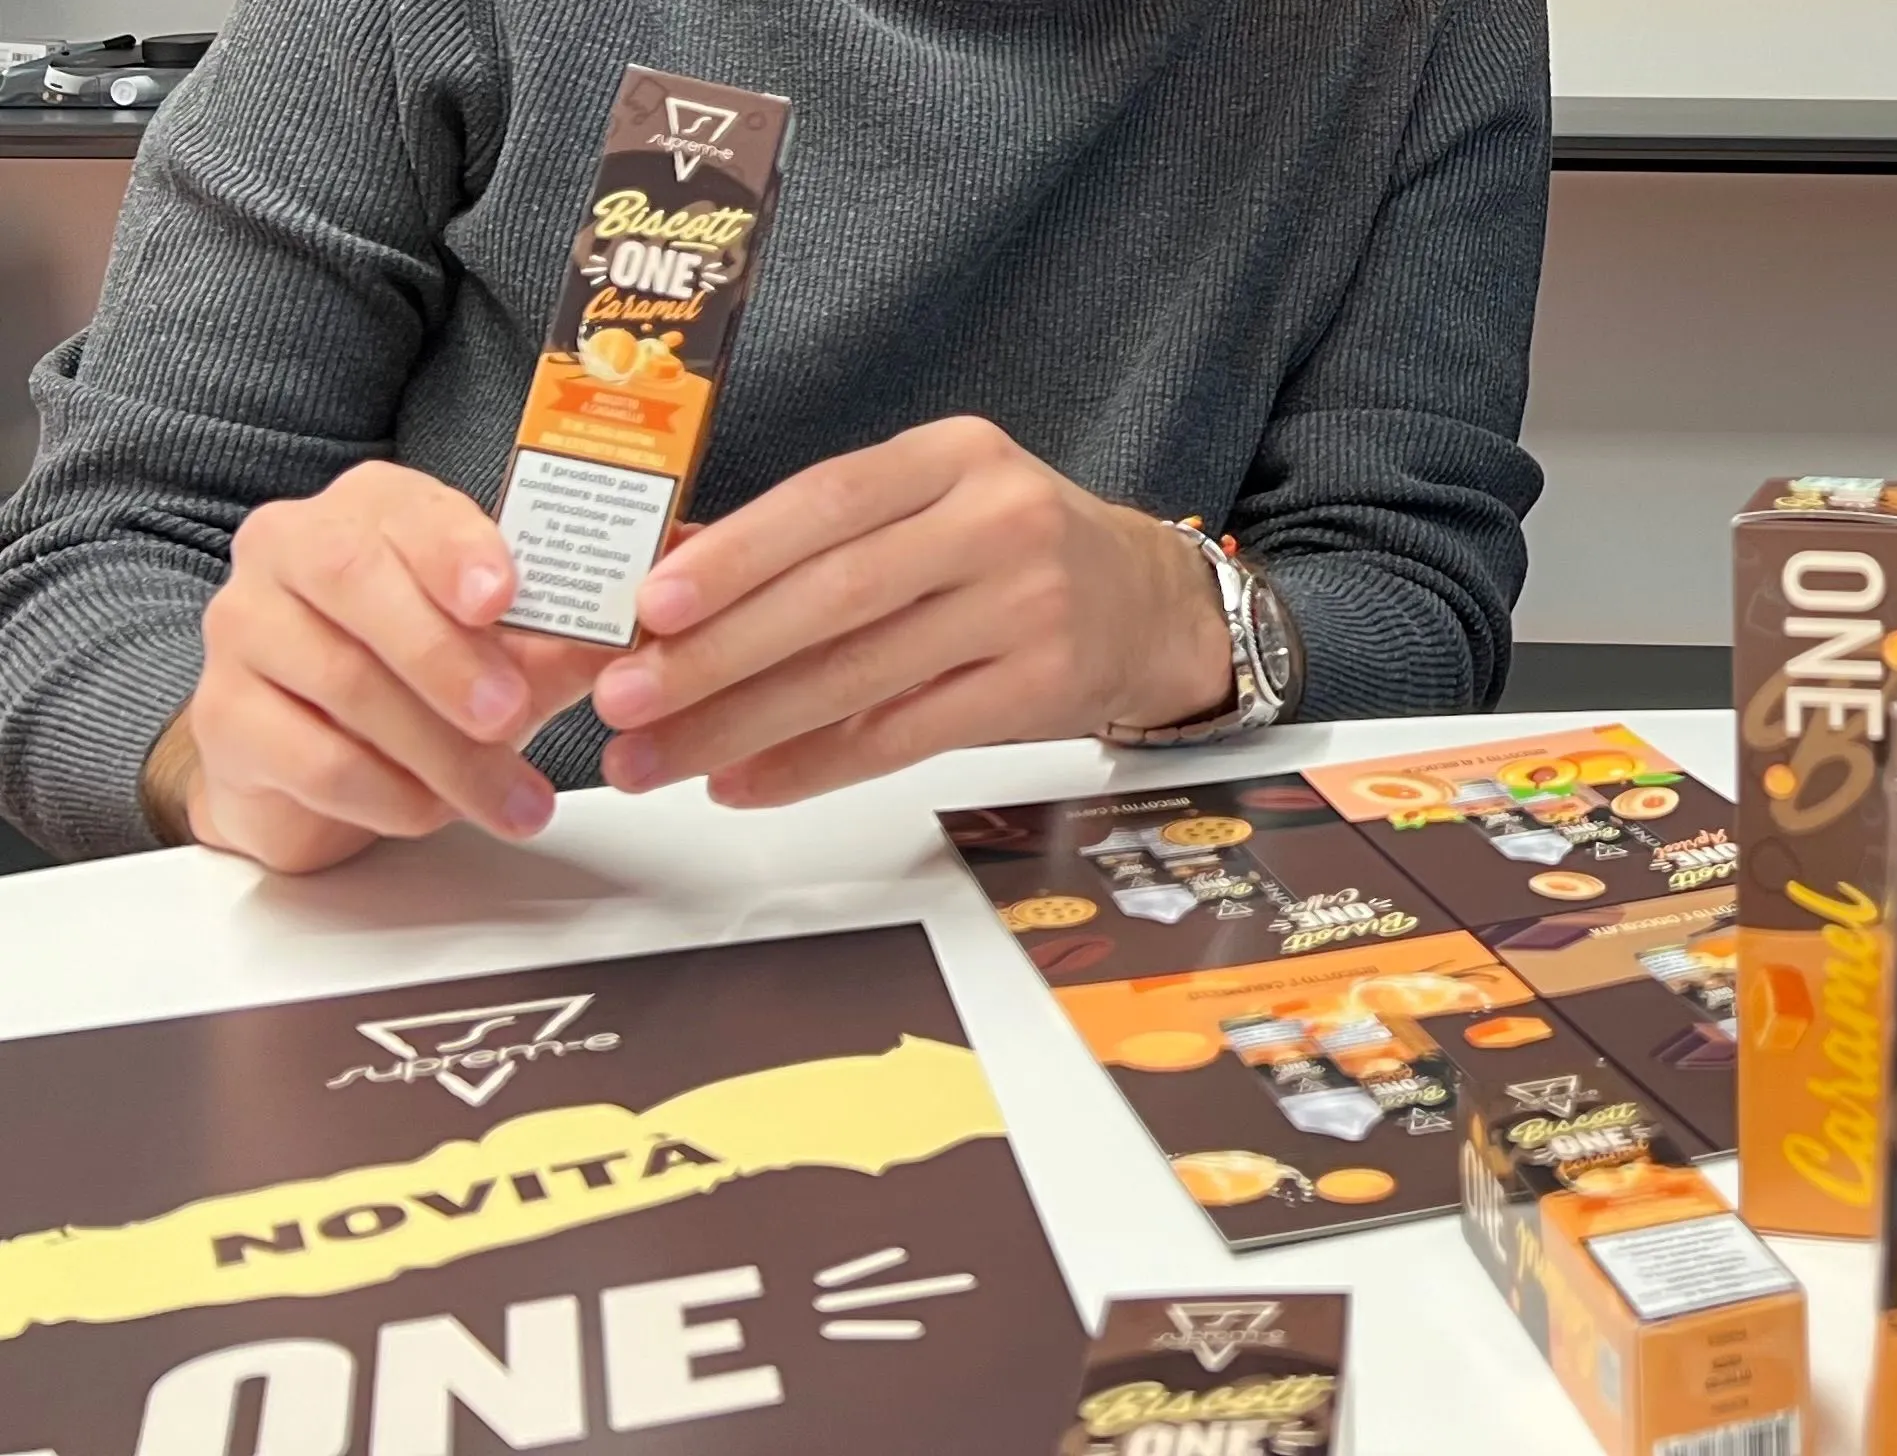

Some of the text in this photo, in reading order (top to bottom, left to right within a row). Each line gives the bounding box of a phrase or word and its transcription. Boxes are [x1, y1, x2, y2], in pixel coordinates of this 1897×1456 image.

[592, 190, 752, 243] Biscott
[610, 240, 703, 299] ONE
[583, 287, 706, 321] Caramel
[1781, 551, 1887, 741] ONE
[1278, 886, 1360, 915] Coffee
[1287, 899, 1375, 931] ONE
[1281, 912, 1420, 955] Biscott
[326, 1028, 622, 1091] suprem-e
[1783, 881, 1881, 1207] Caramel
[1507, 1102, 1640, 1144] Biscott
[1548, 1124, 1633, 1158] ONE
[210, 1132, 728, 1269] NOVITÀ
[132, 1264, 788, 1456] ONE
[1079, 1374, 1336, 1437] Biscott
